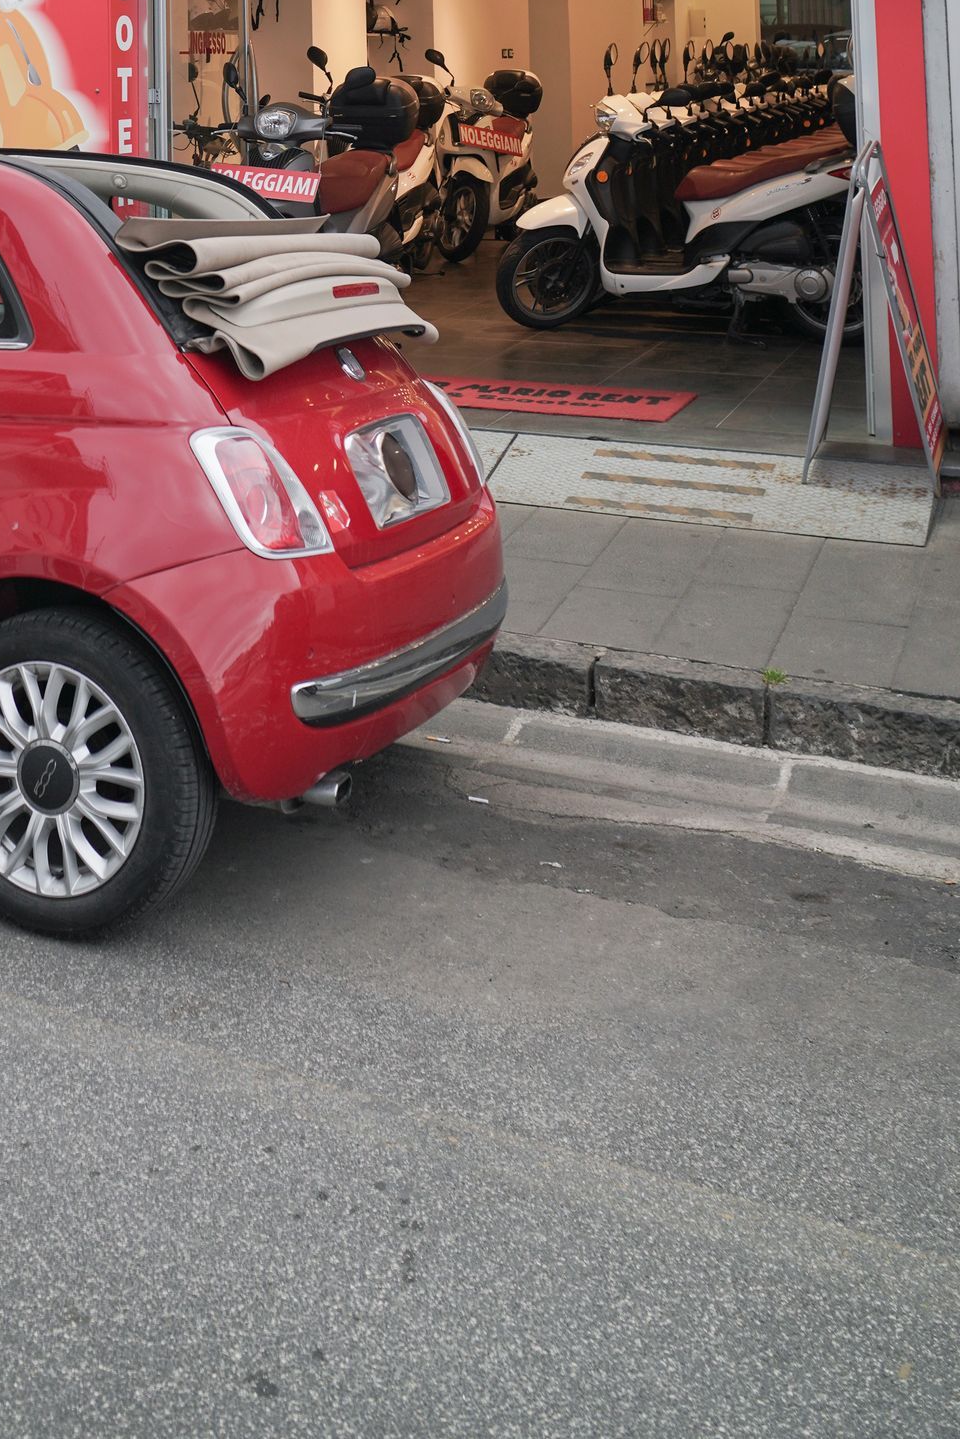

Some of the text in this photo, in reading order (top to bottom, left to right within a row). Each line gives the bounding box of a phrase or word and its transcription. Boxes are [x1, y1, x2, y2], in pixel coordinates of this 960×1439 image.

[190, 31, 226, 55] INGRESSO
[460, 126, 523, 155] NOLEGGIAMI
[211, 168, 319, 196] EGGIAMI
[456, 383, 571, 399] MARIO
[576, 392, 673, 406] RENT
[478, 394, 606, 408] Scooter
